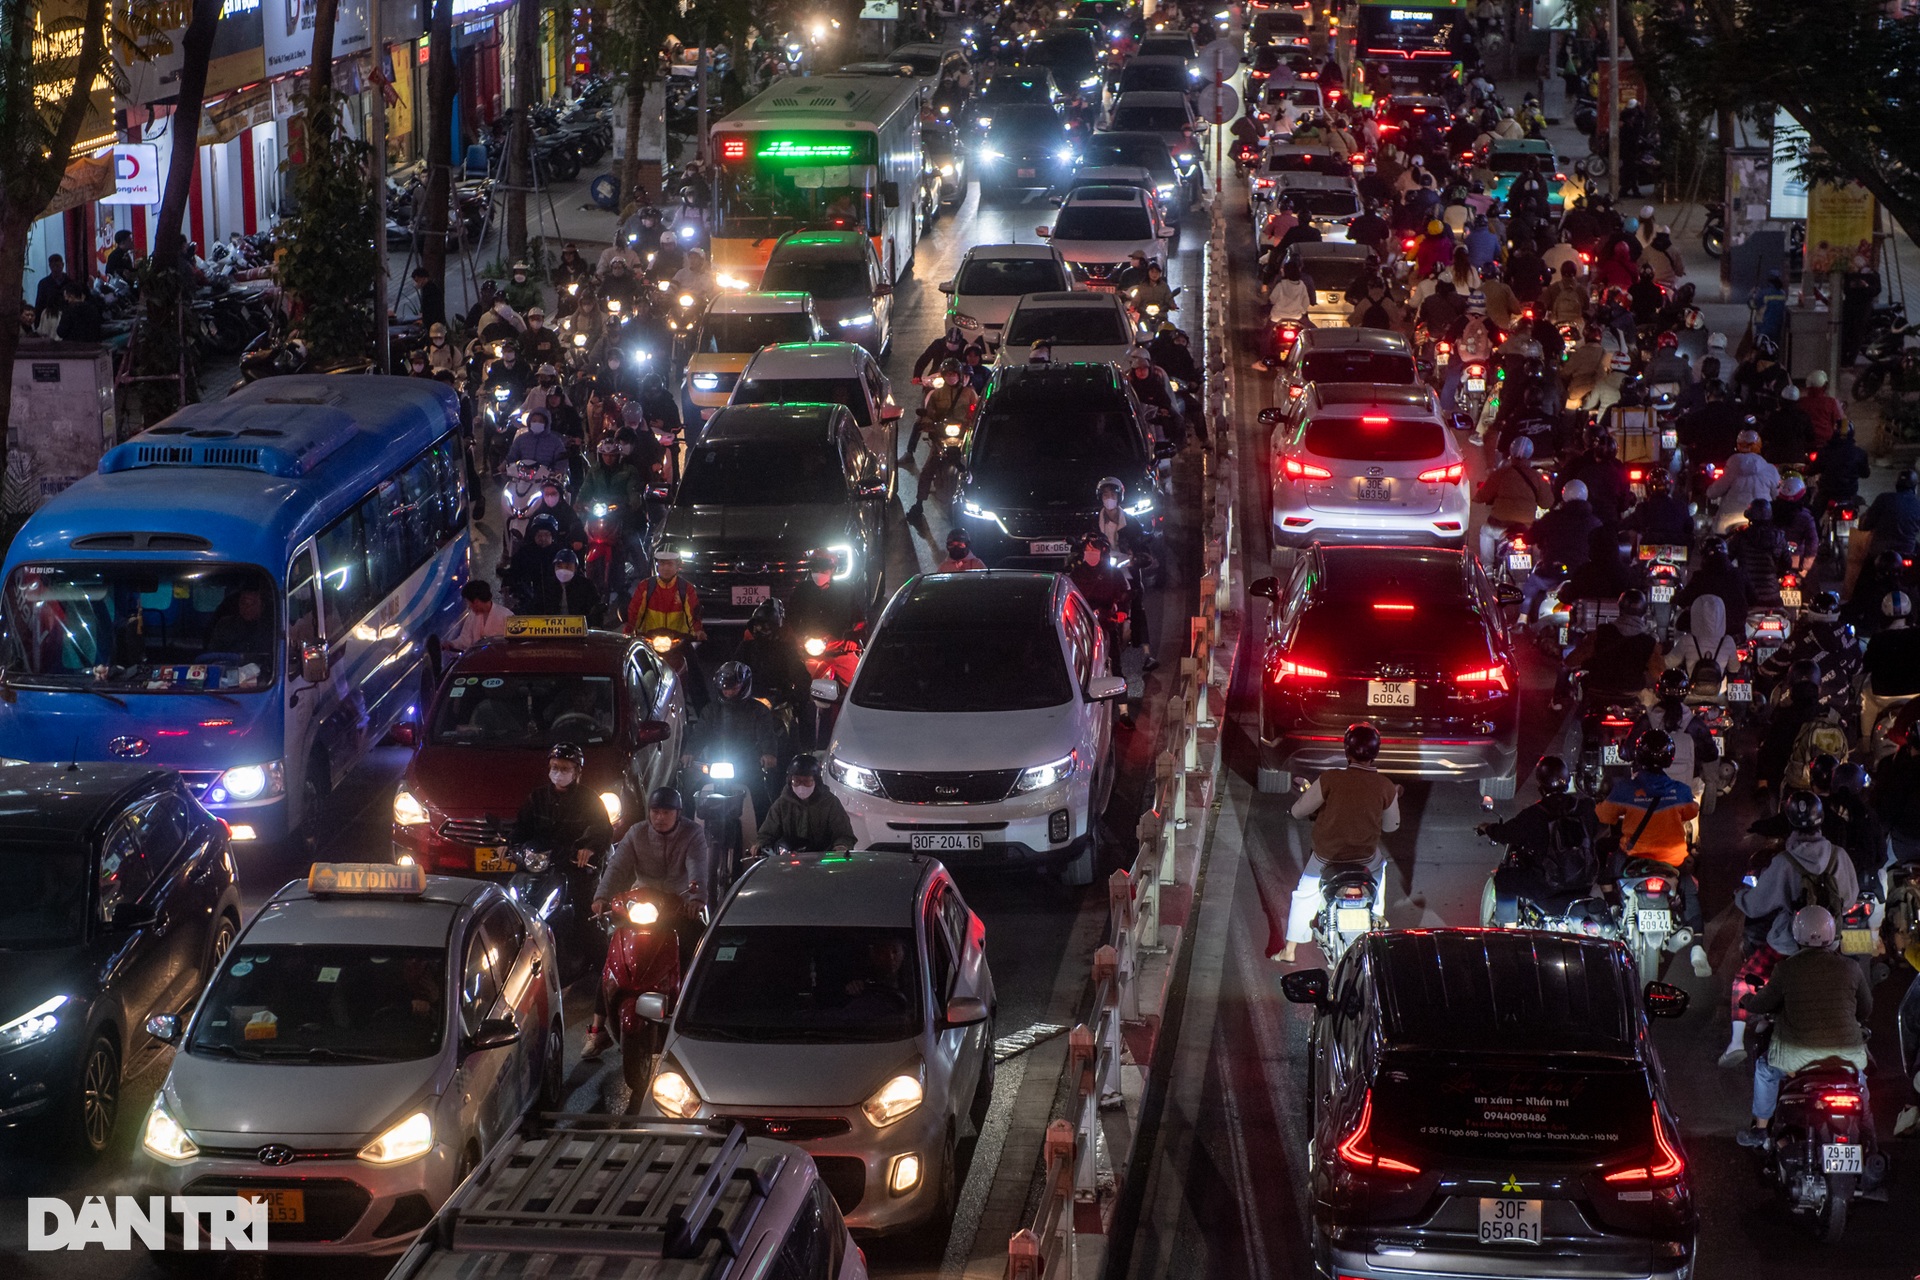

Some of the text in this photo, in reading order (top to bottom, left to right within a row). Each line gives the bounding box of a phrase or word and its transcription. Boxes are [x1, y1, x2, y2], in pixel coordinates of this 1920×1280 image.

[742, 587, 759, 595] 30K
[545, 618, 566, 626] TAXI
[1382, 683, 1401, 693] 30K
[1373, 694, 1410, 704] 608.46
[913, 836, 980, 849] 30F-204.16
[336, 868, 413, 889] MỸ ĐÌNH
[1483, 1111, 1547, 1122] 0944098486
[1828, 1147, 1856, 1158] 29-BF
[1494, 1201, 1527, 1220] 30F
